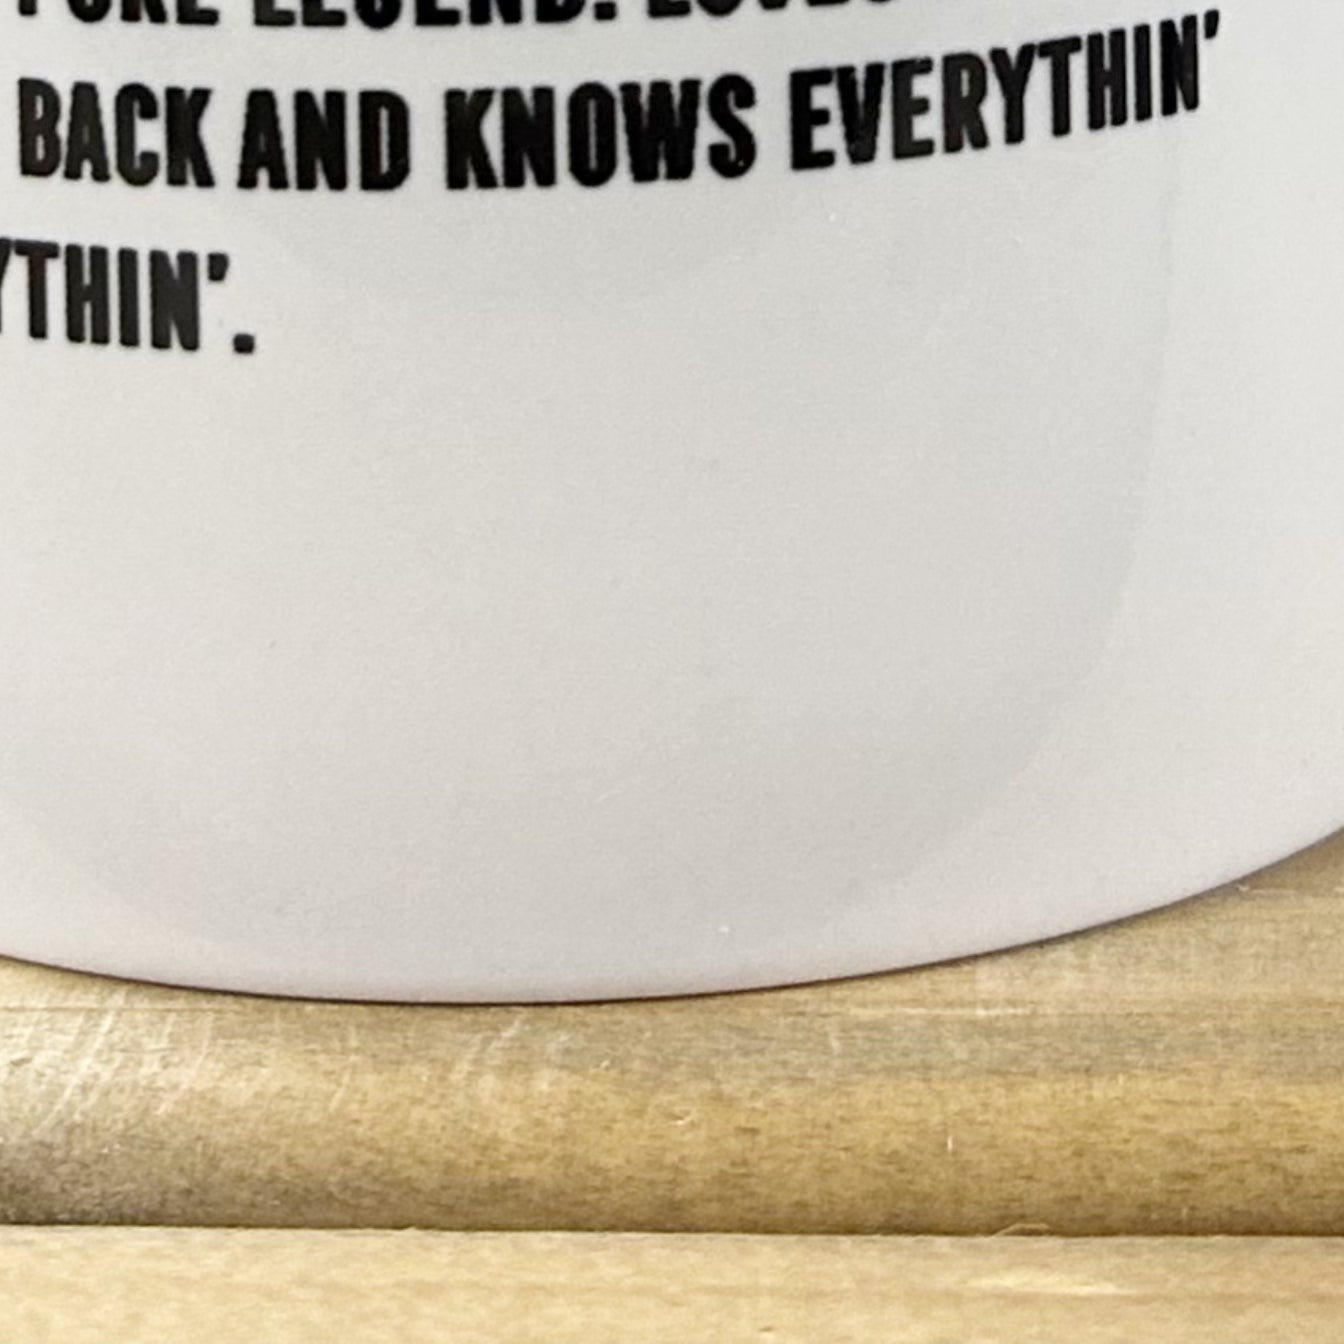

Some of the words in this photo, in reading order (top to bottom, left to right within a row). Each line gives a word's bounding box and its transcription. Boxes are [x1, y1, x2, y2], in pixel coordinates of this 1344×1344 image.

[17, 77, 216, 189] BACK
[237, 88, 411, 192] AND
[444, 73, 757, 191] KNOWS
